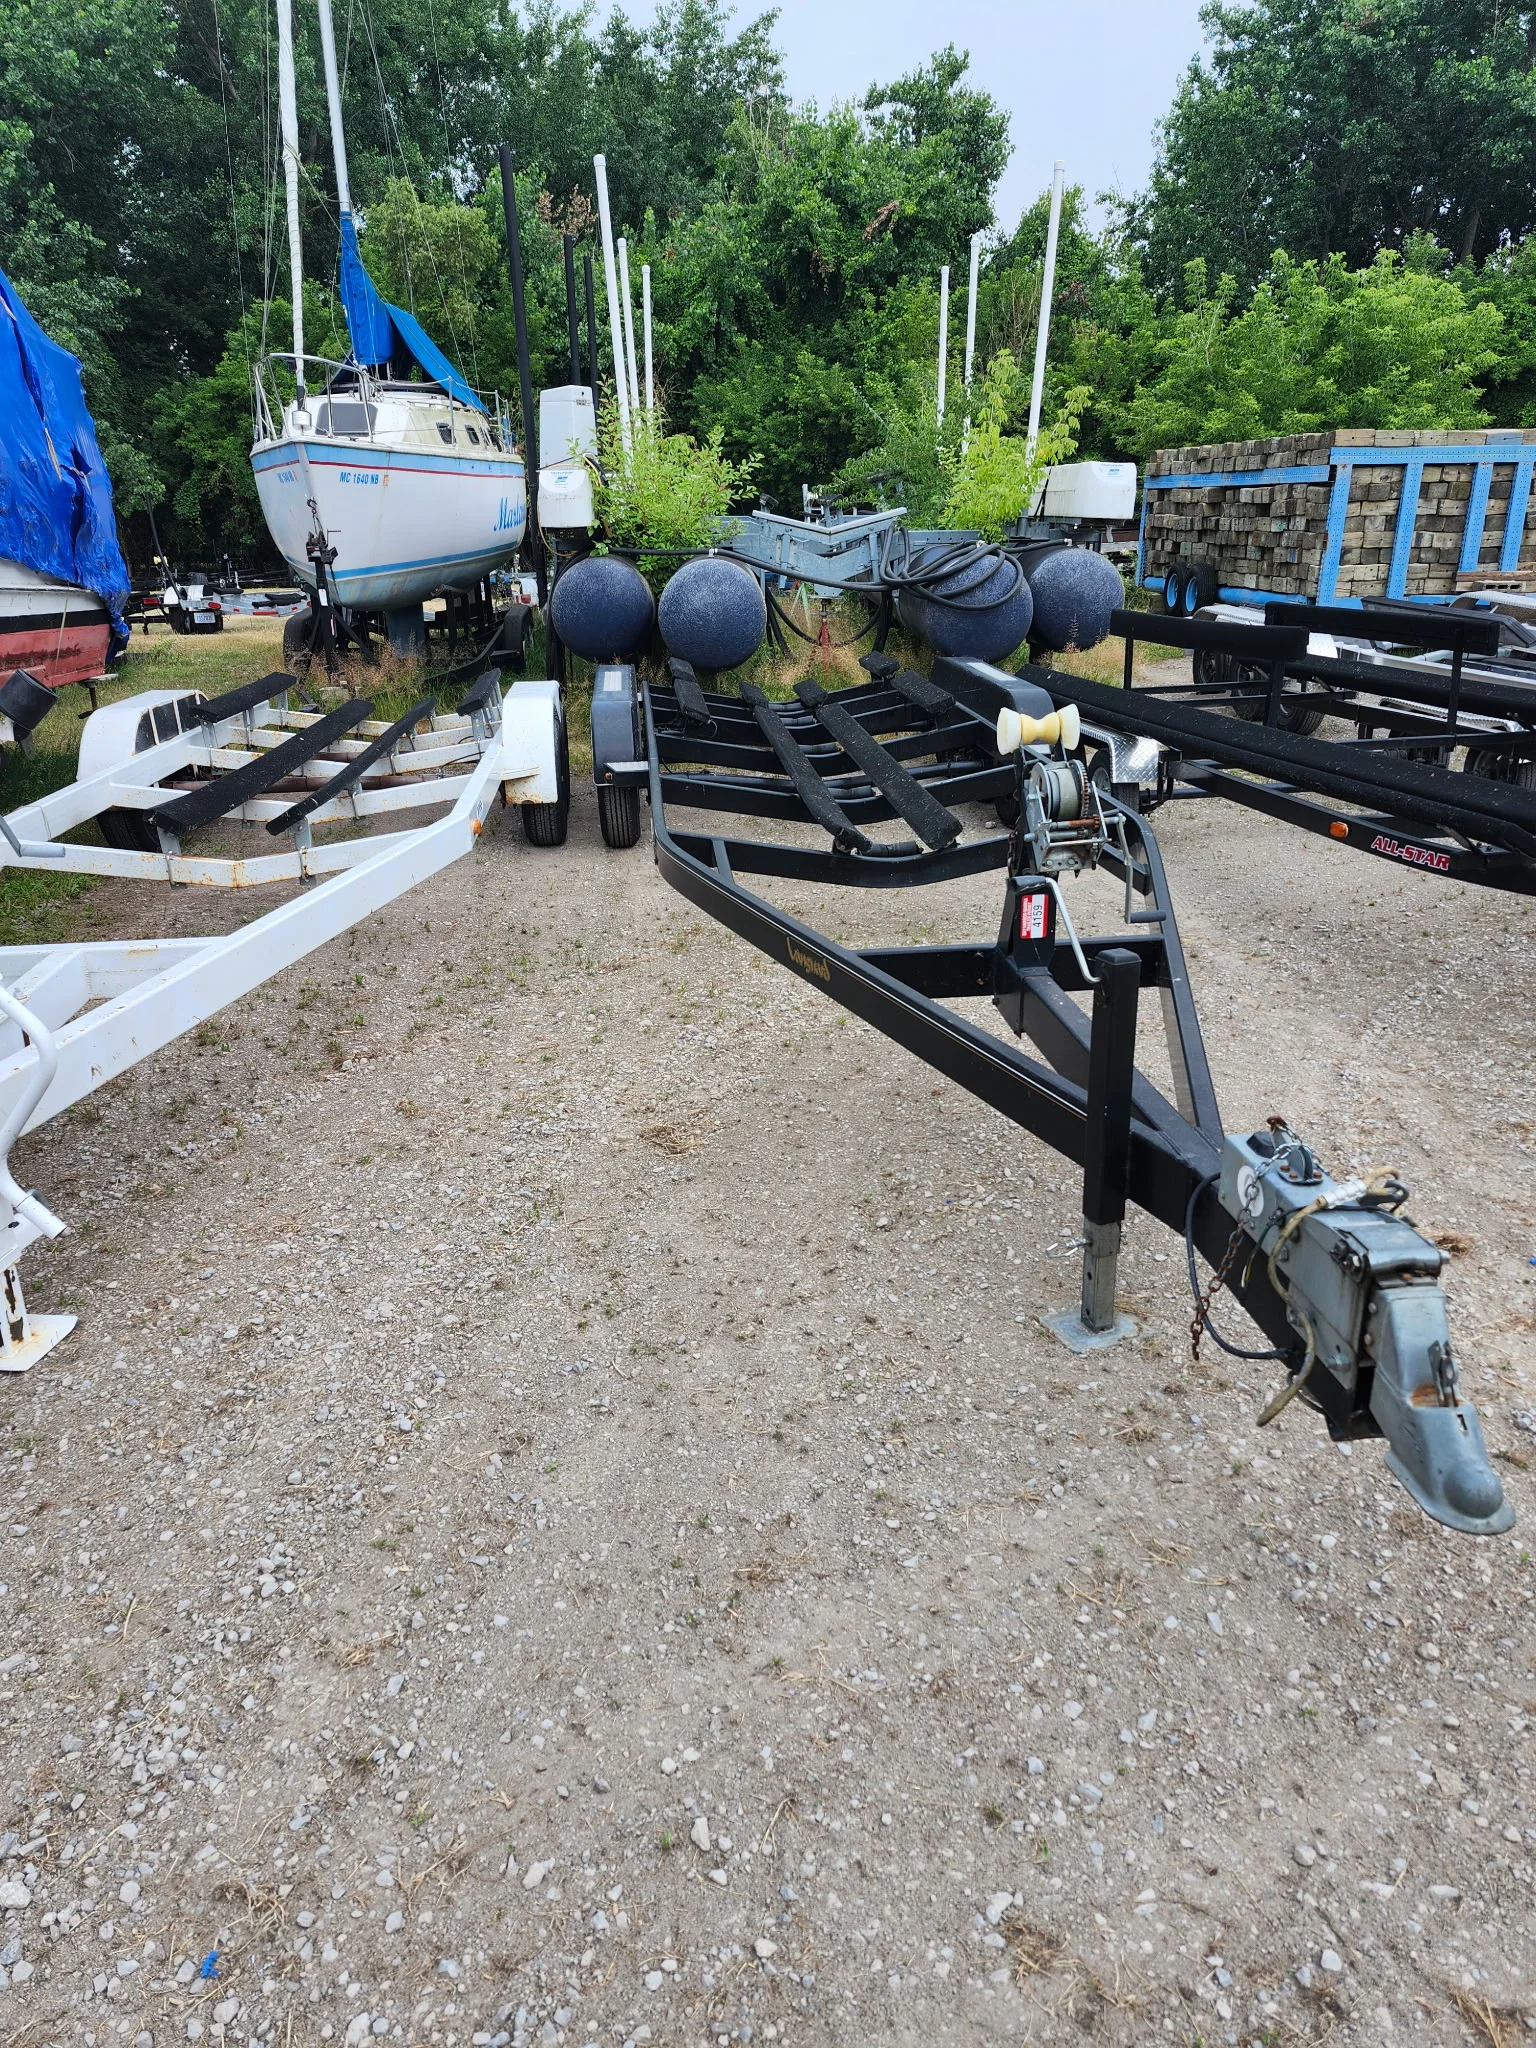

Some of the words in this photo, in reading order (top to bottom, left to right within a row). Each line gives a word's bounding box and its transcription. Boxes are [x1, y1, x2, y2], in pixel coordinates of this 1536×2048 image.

[340, 472, 351, 483] MC
[353, 473, 369, 484] 1640
[370, 474, 379, 484] NB
[1371, 835, 1451, 870] ALL-STAR
[1033, 905, 1042, 927] 4159
